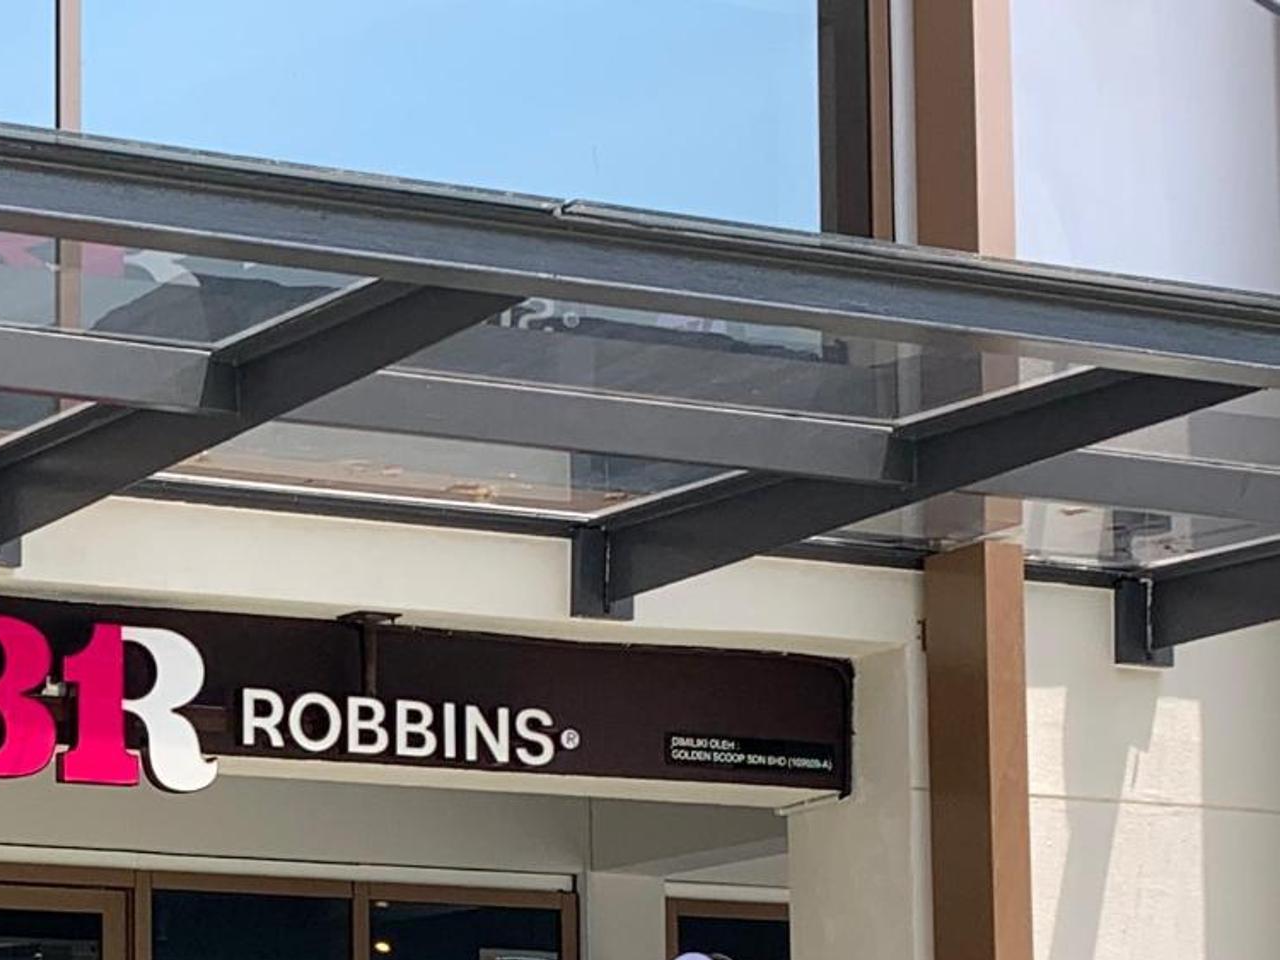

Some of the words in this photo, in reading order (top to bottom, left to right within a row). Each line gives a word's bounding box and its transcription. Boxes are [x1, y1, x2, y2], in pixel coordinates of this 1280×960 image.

[671, 750, 712, 761] GOLDEN
[713, 751, 745, 763] SCOOP
[747, 753, 766, 765] SDN
